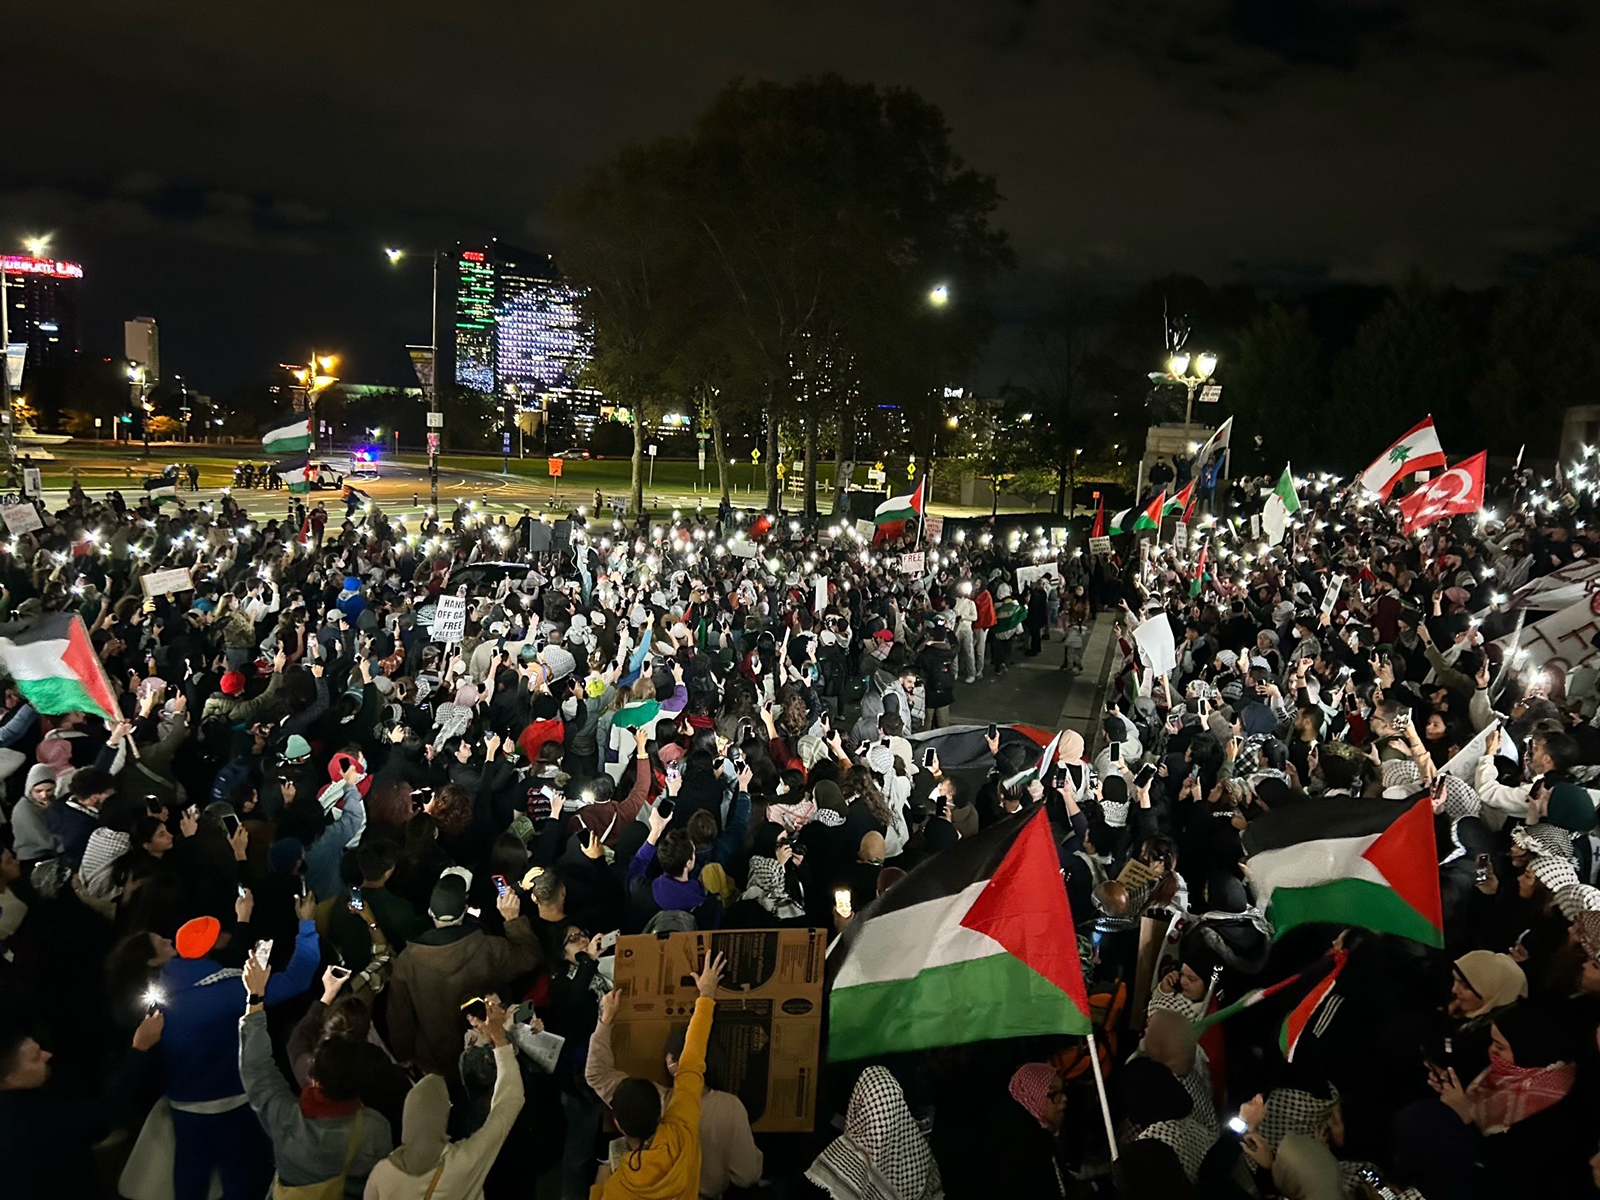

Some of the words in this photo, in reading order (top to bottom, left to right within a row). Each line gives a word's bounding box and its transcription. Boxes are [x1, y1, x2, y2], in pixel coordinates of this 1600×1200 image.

[2, 495, 20, 504] END
[903, 553, 922, 563] FREE
[437, 610, 452, 619] OFF
[453, 610, 465, 619] GAZ
[443, 621, 462, 630] FREE
